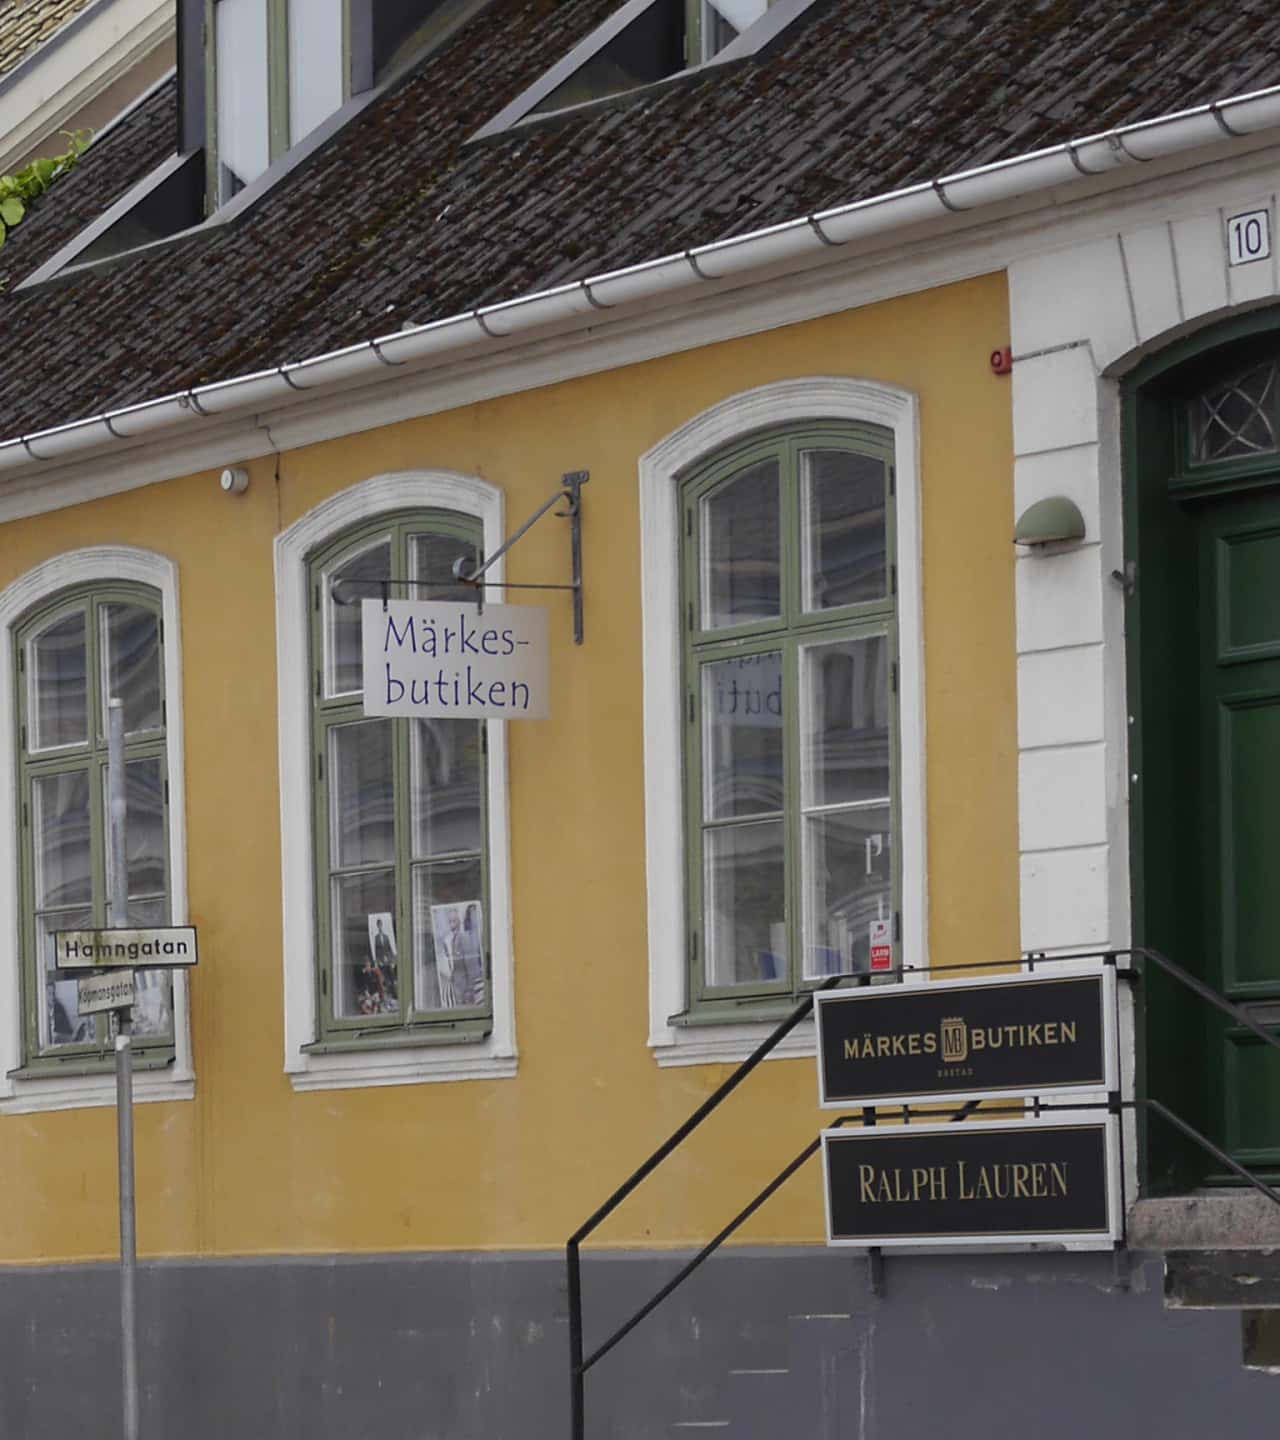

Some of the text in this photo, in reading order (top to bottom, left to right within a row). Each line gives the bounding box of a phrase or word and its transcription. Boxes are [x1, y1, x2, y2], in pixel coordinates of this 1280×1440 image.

[1235, 218, 1262, 259] 10
[384, 613, 529, 658] Märkes-
[386, 662, 529, 709] butiken
[65, 938, 188, 960] Hamngatan
[843, 1021, 1077, 1060] MÄRKES BUTIKEN
[858, 1160, 1069, 1203] RALPH LAUREN
